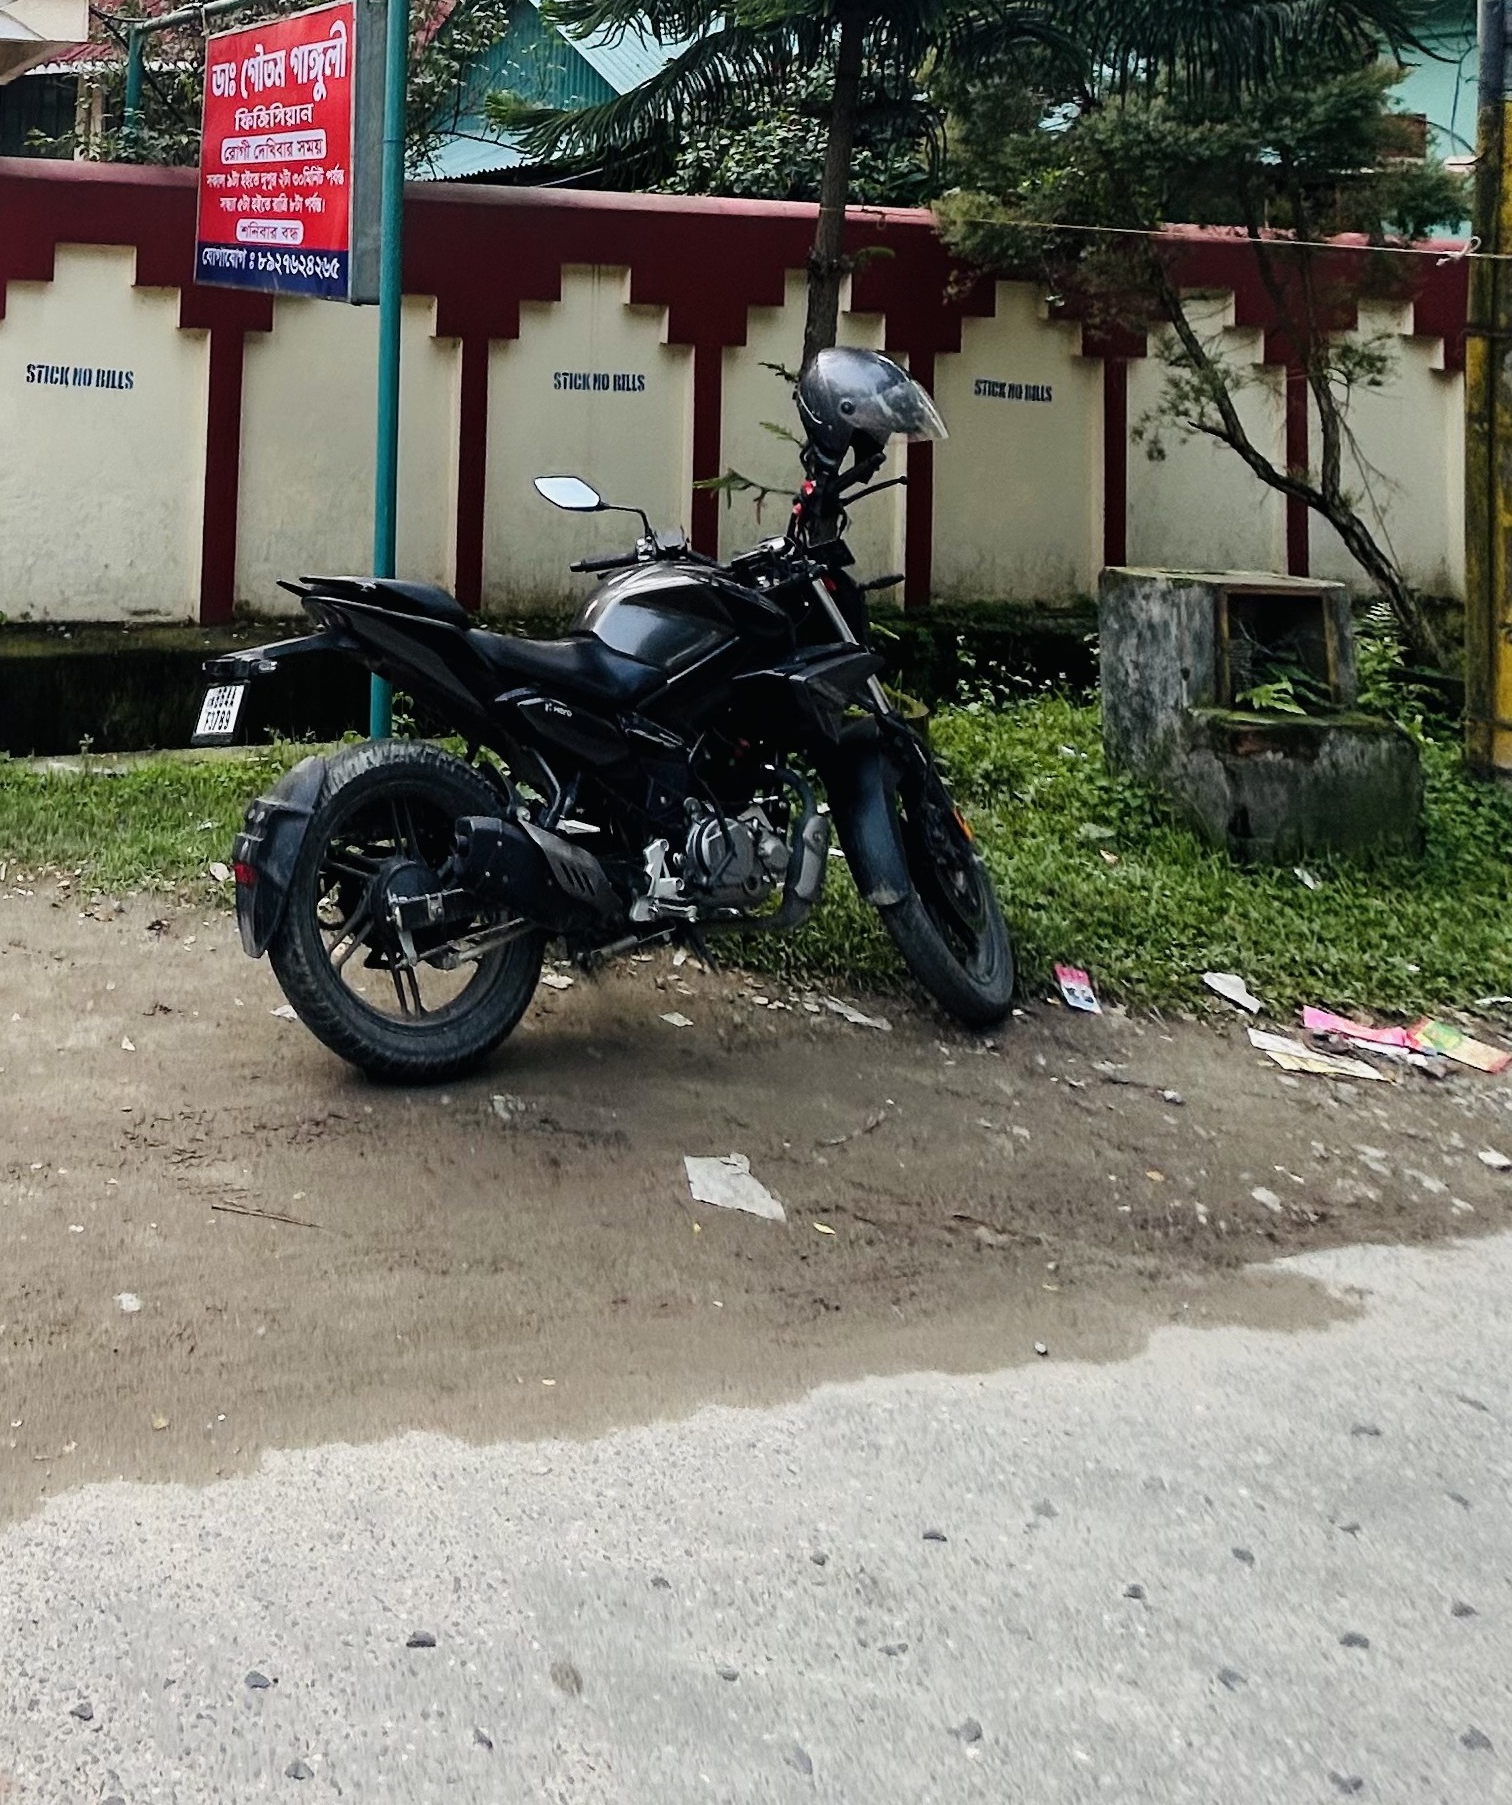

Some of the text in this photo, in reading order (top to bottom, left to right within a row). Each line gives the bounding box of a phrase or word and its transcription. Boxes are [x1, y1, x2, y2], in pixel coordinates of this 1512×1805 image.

[212, 20, 347, 102] ডাঃ গৌতম গাঙ্গুলী
[224, 139, 250, 161] রোগী
[297, 138, 324, 156] সময়
[241, 221, 300, 241] শনিবার বন্ধ
[26, 363, 134, 390] STICK NO BILLS
[553, 372, 645, 392] STICK NO BILLS
[974, 378, 1052, 402] STICK NO BILLS
